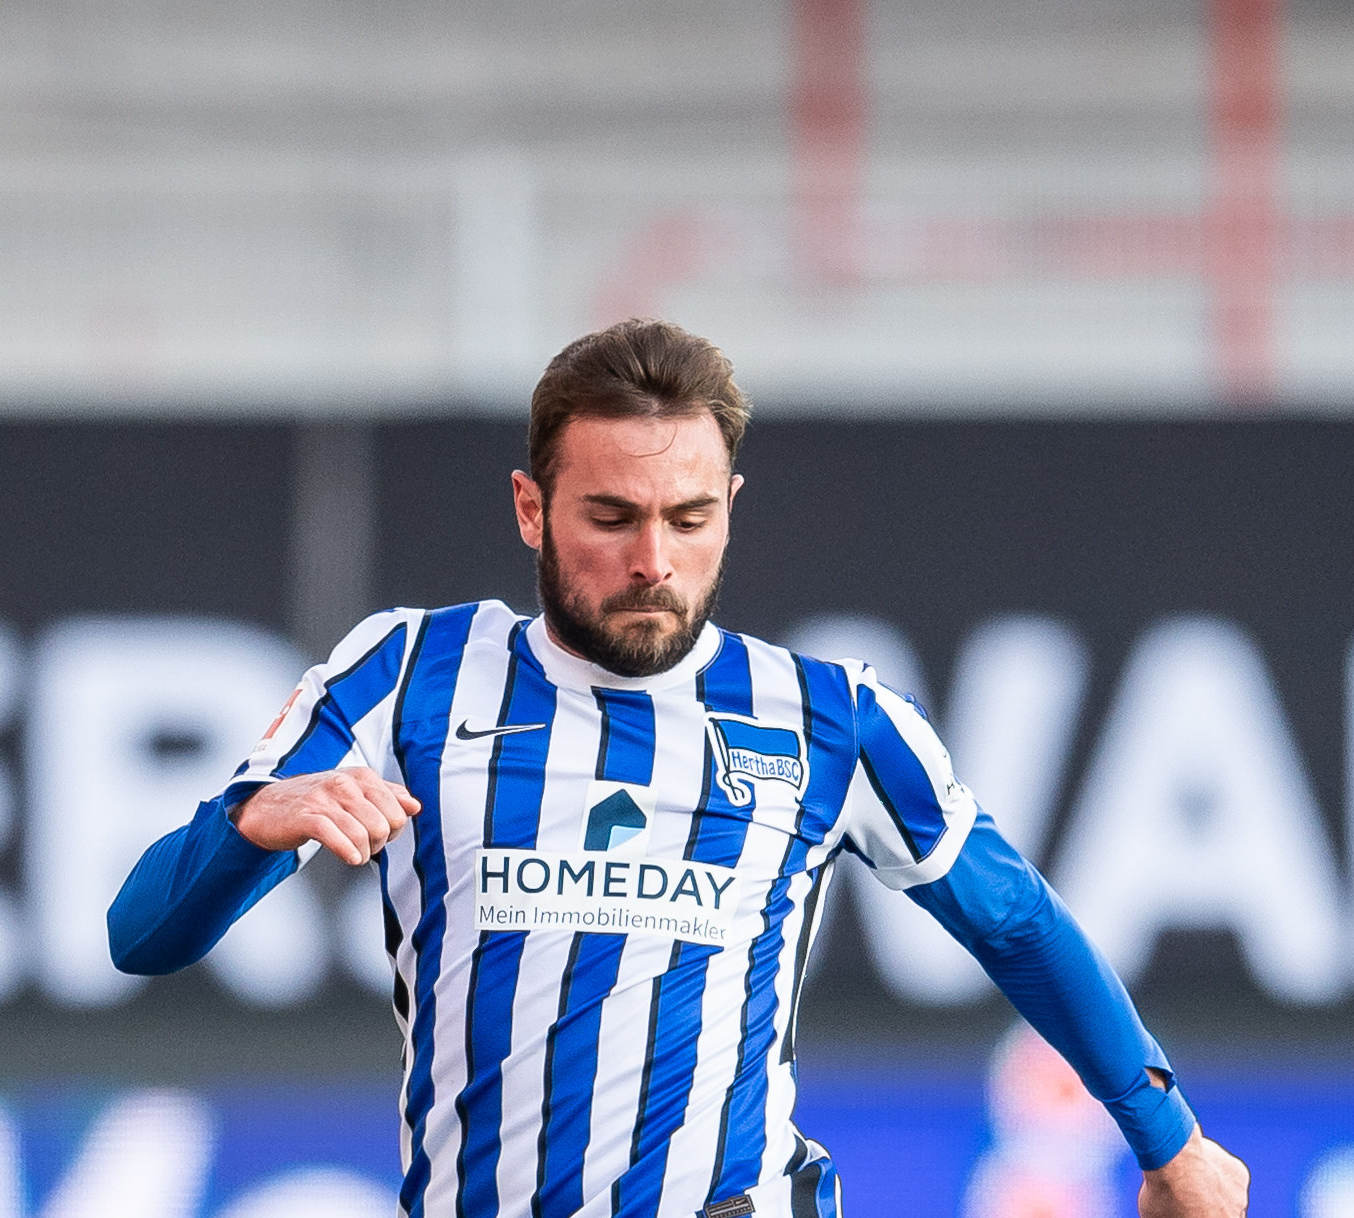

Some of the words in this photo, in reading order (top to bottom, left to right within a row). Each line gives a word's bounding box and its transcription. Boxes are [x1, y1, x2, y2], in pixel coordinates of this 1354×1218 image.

[481, 856, 736, 910] HOMEDAY
[479, 905, 526, 924] Mein
[533, 907, 727, 940] Immobilienmakler
